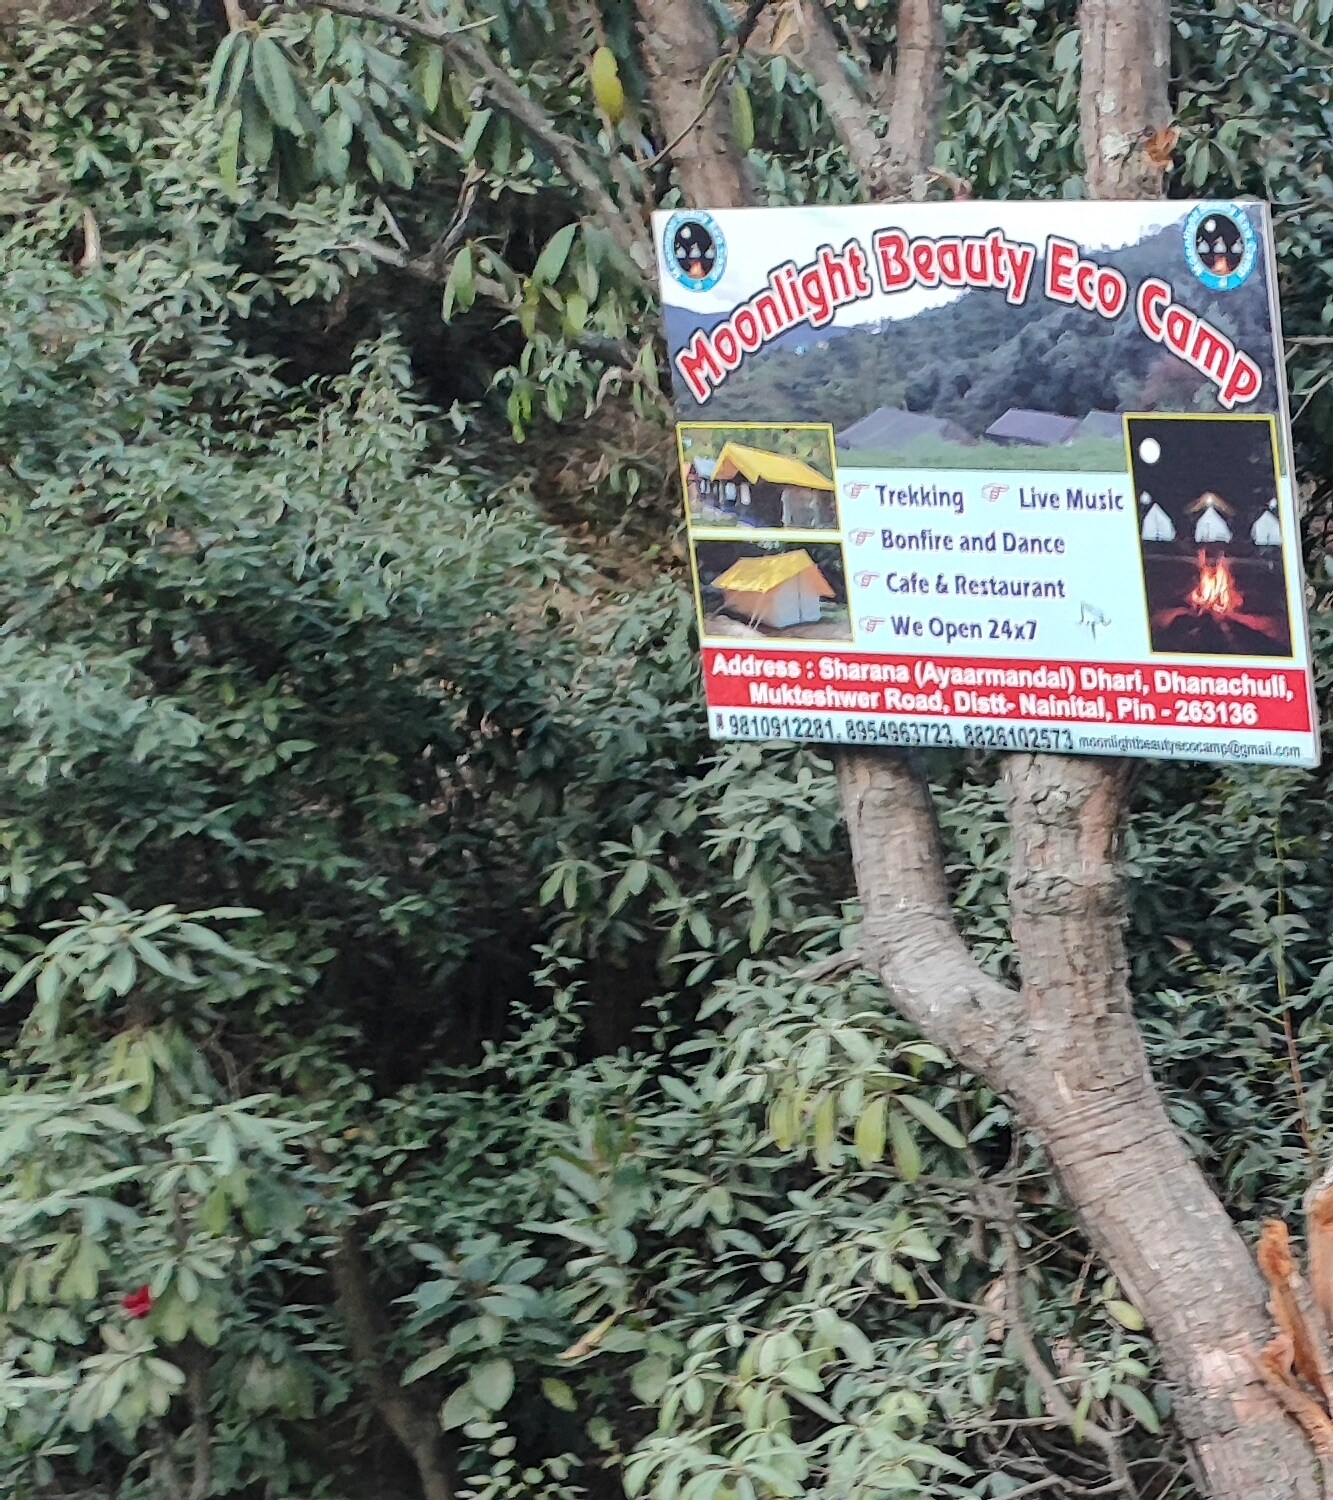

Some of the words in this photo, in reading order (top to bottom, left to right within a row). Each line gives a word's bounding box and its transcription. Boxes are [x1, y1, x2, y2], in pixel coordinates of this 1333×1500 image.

[676, 240, 871, 403] Moonlight
[873, 227, 1036, 306] Beauty
[1046, 235, 1127, 319] Eco
[1136, 278, 1262, 409] Camp
[875, 484, 965, 514] Trekking
[1019, 486, 1060, 511] Live
[1066, 488, 1124, 511] Music
[881, 529, 954, 550] Bonfire
[959, 531, 997, 552] and
[1003, 532, 1066, 554] Dance
[886, 572, 929, 594] Cafe
[935, 574, 949, 594] &
[955, 575, 1066, 598] Restaurant
[891, 615, 923, 636] We
[928, 617, 983, 645] Open
[989, 619, 1038, 641] 24x7
[711, 652, 802, 678] Address
[818, 656, 910, 684] Sharana
[915, 660, 1076, 695] (Ayaarmandal)
[1080, 667, 1151, 695] Dhari,
[1155, 669, 1295, 701] Dhanachuli,
[749, 681, 881, 710] Mukteshwer
[885, 687, 951, 715] Road,
[1019, 693, 1114, 722] Nainital,
[1116, 697, 1157, 722] Pin
[1175, 699, 1259, 725] 263136
